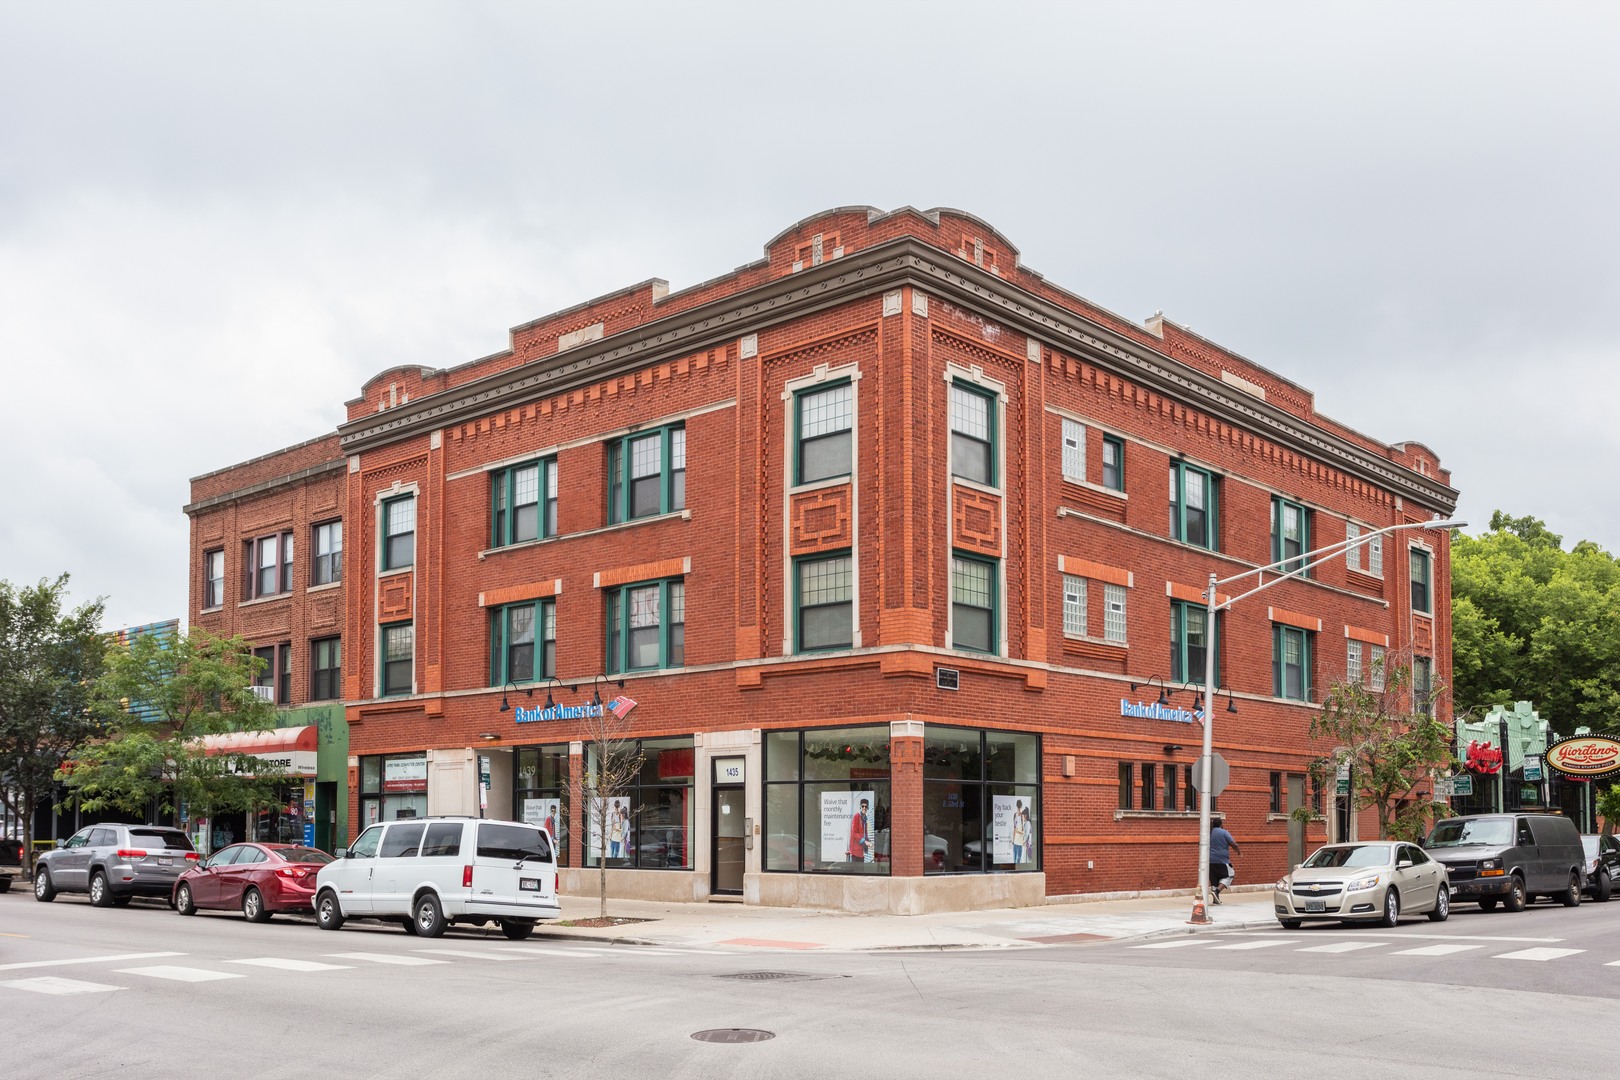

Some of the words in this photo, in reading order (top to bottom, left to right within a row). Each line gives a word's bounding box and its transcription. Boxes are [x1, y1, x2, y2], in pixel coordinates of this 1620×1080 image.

[516, 705, 543, 723] Bank
[543, 706, 556, 721] of
[556, 701, 604, 719] America
[1121, 698, 1146, 718] Bank
[1146, 702, 1157, 719] of
[1156, 703, 1193, 723] America
[1557, 744, 1619, 761] Giordano's
[268, 759, 291, 768] TORE
[726, 767, 739, 777] 1435
[824, 806, 842, 814] monthly
[994, 803, 1002, 811] Pay
